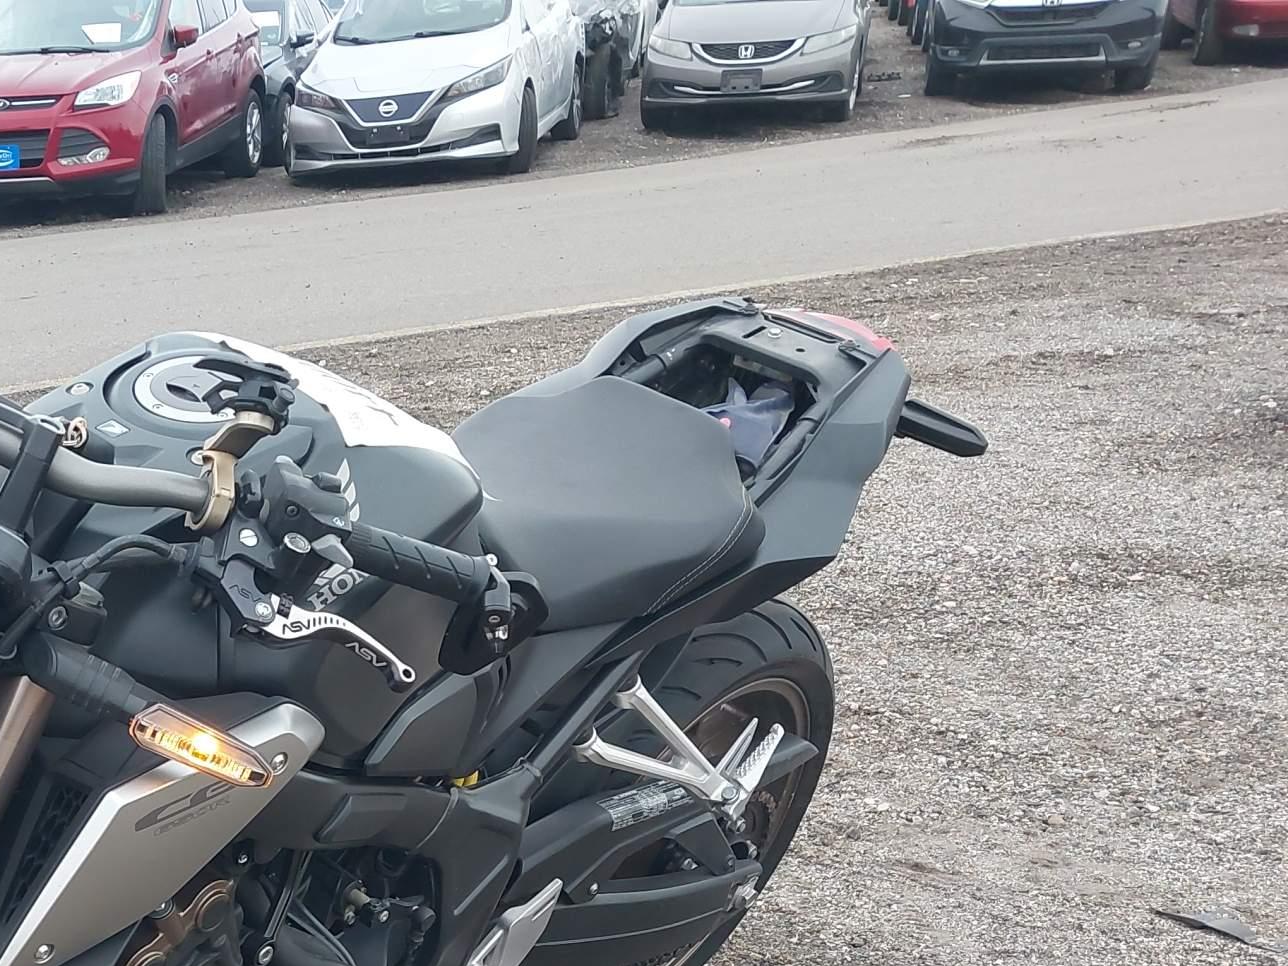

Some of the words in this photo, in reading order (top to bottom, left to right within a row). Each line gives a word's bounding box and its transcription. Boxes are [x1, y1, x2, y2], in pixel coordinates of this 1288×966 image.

[228, 584, 262, 602] ASV
[282, 618, 311, 635] ASV
[344, 642, 388, 668] ASV
